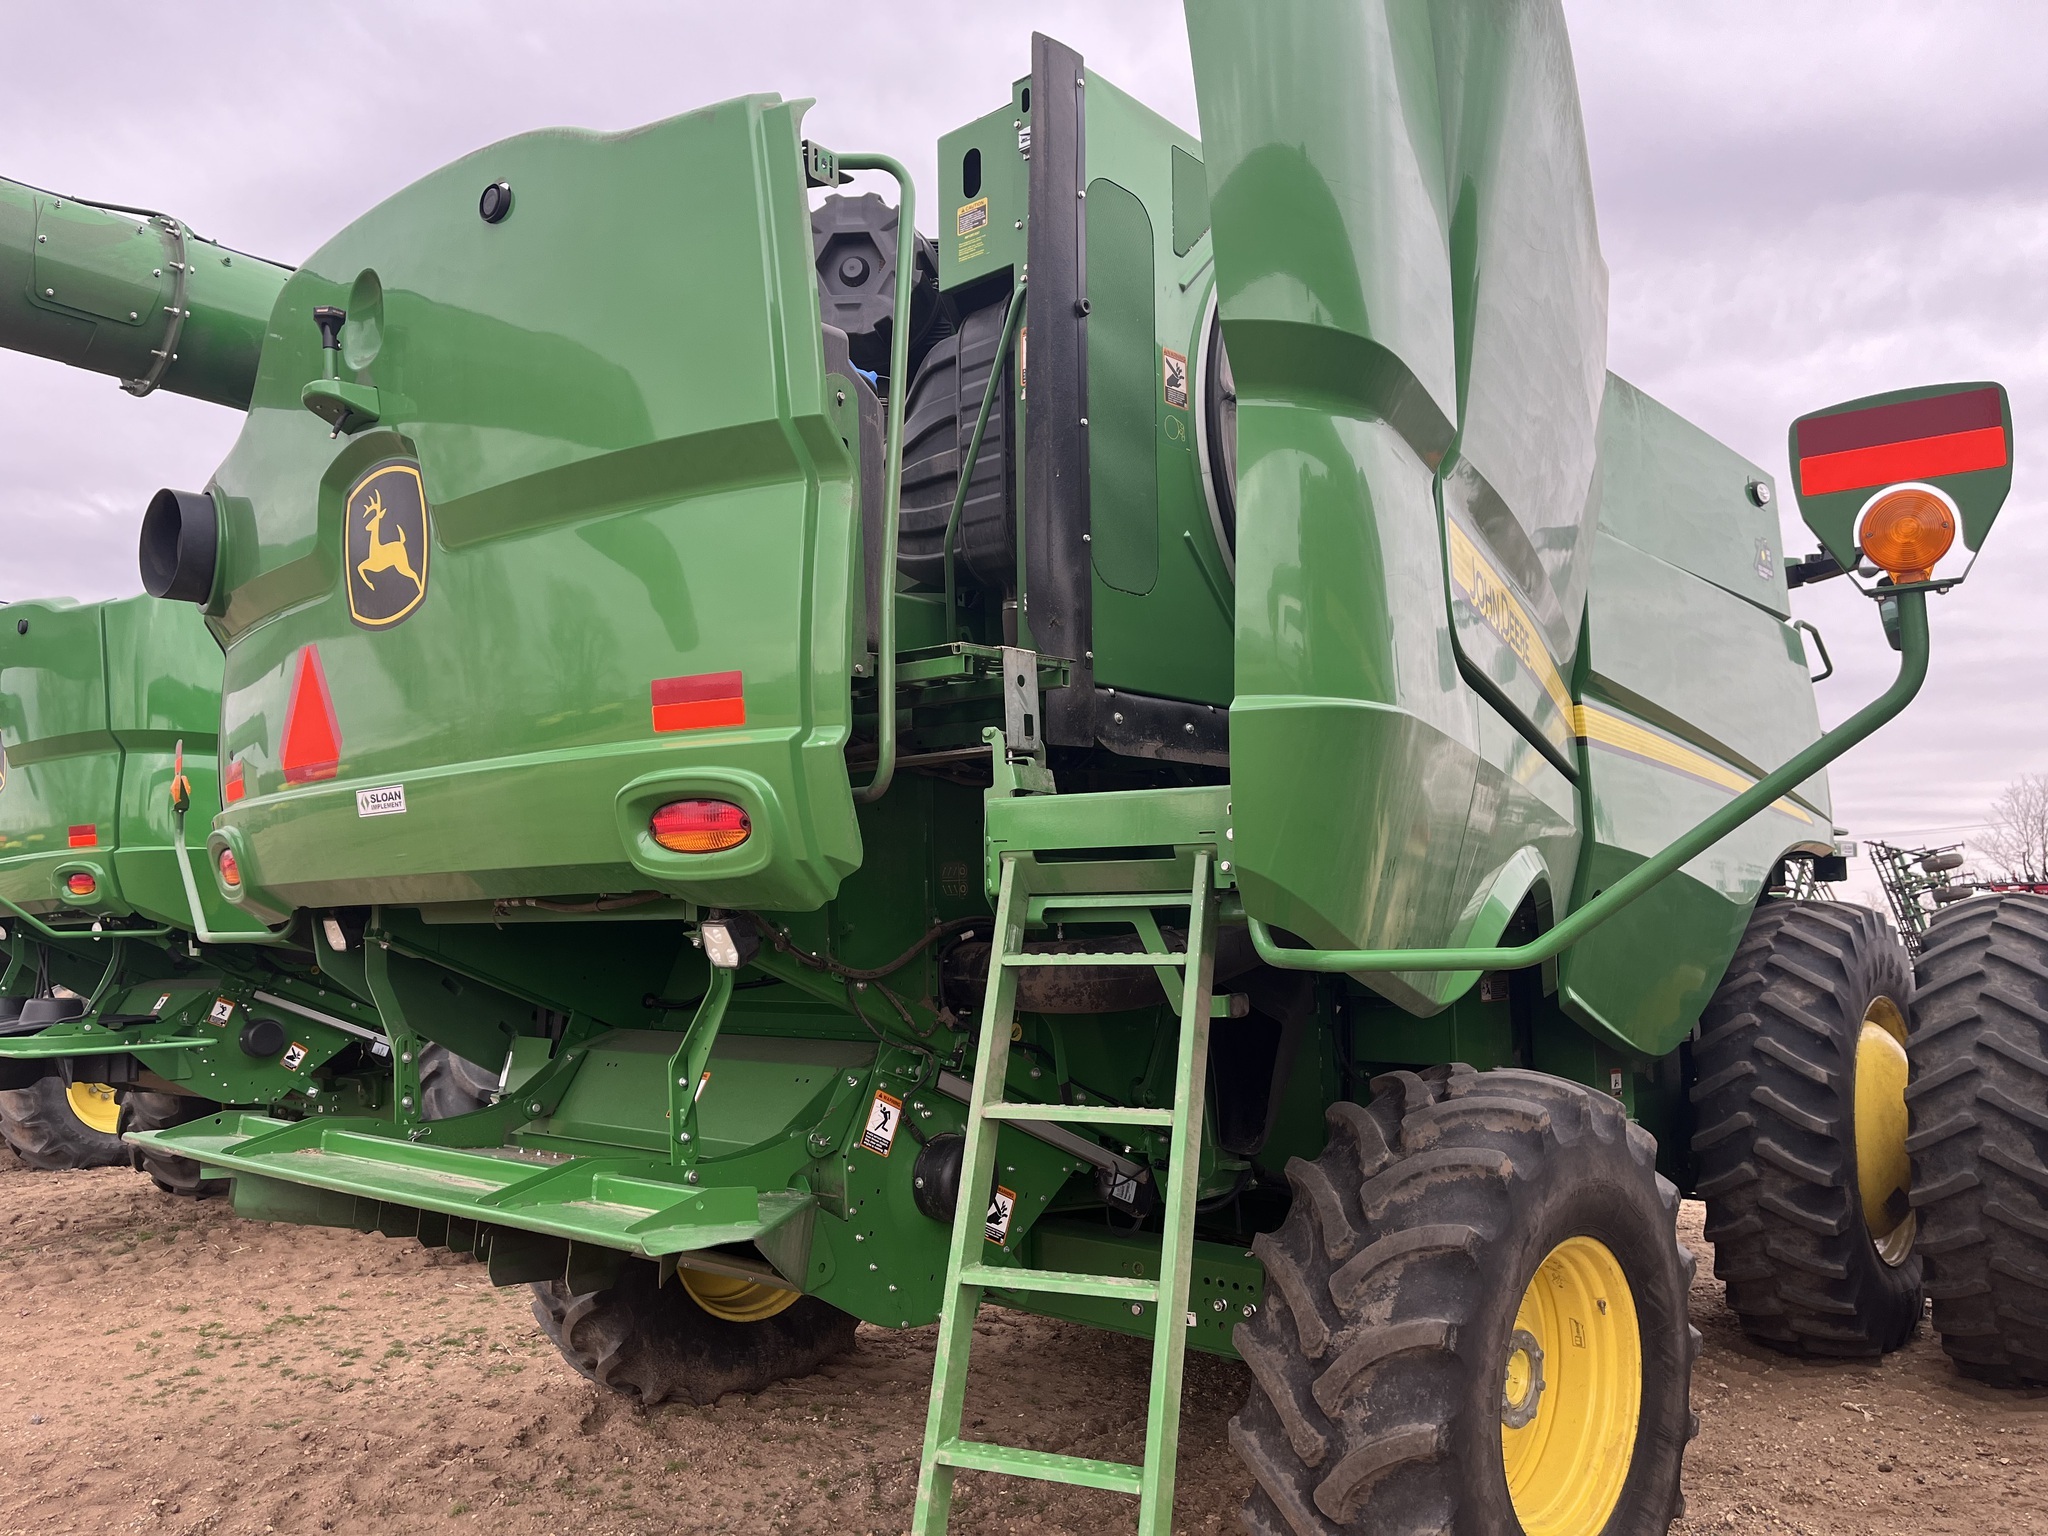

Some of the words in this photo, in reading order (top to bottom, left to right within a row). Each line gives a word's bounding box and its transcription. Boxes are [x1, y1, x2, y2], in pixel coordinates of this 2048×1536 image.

[966, 200, 985, 211] CAUTION
[1469, 556, 1500, 622] JOHN
[1501, 590, 1531, 664] DEERE
[370, 791, 402, 803] SLOAN
[371, 801, 402, 810] IMPLEMENT
[883, 1095, 901, 1107] WARNING
